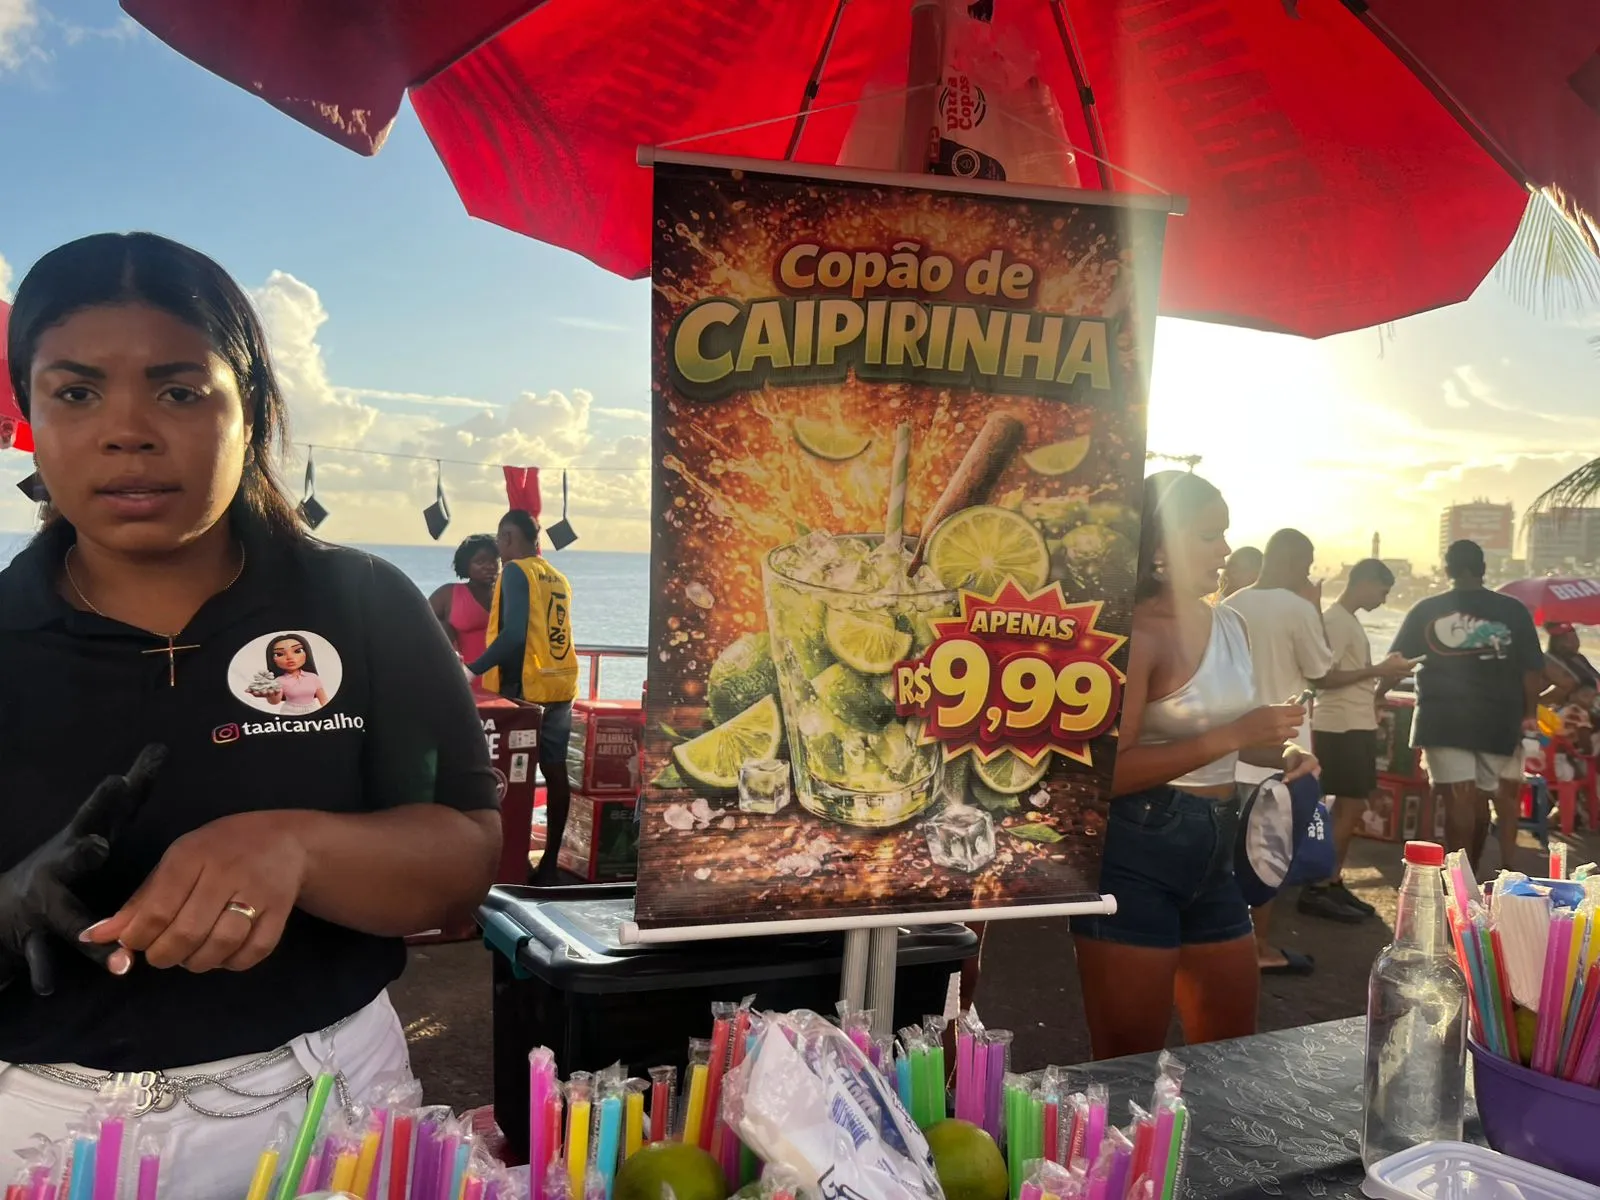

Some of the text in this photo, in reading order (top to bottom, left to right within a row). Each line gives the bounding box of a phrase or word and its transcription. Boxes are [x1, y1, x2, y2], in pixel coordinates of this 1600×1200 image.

[959, 75, 975, 131] Copos
[780, 242, 1034, 299] Copão de
[674, 300, 1111, 390] CAIPIRINHA
[1548, 579, 1600, 600] BRA
[970, 610, 1077, 641] APENAS
